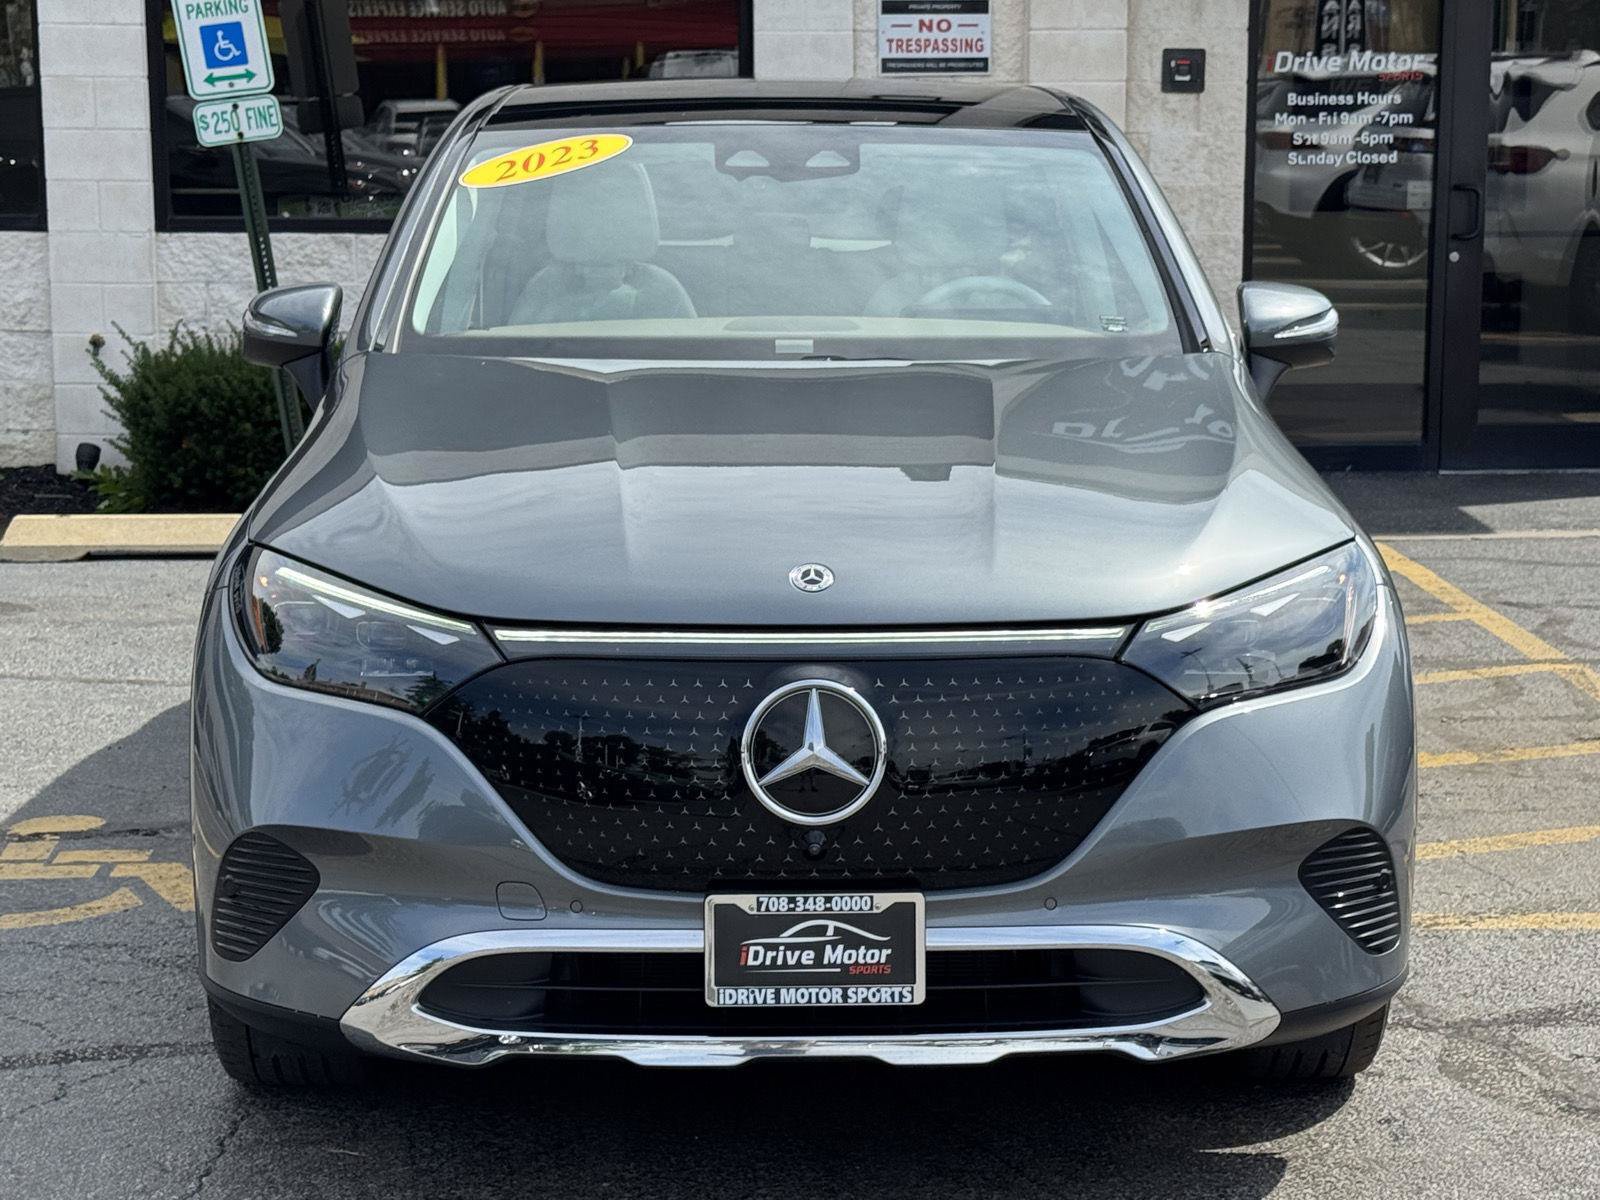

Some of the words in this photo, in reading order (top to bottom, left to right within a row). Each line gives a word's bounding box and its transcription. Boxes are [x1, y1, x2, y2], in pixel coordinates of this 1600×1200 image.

[185, 0, 249, 20] PARKING
[918, 18, 952, 33] NO
[886, 38, 985, 53] TRESPASSING
[1348, 50, 1425, 72] Motor
[1287, 92, 1354, 106] Business
[1357, 91, 1402, 105] Hours
[199, 109, 241, 136] $250
[246, 105, 279, 131] FINE
[1275, 112, 1307, 126] Mon
[1318, 112, 1338, 126] Fri
[495, 139, 600, 182] 2023
[1346, 150, 1398, 165] Closed
[758, 896, 872, 912] 708-348-0000
[739, 944, 815, 966] iDrive
[823, 944, 892, 964] Motor
[848, 964, 892, 975] SPORTS
[780, 988, 843, 1004] MOTOR
[847, 987, 913, 1004] SPORTS
